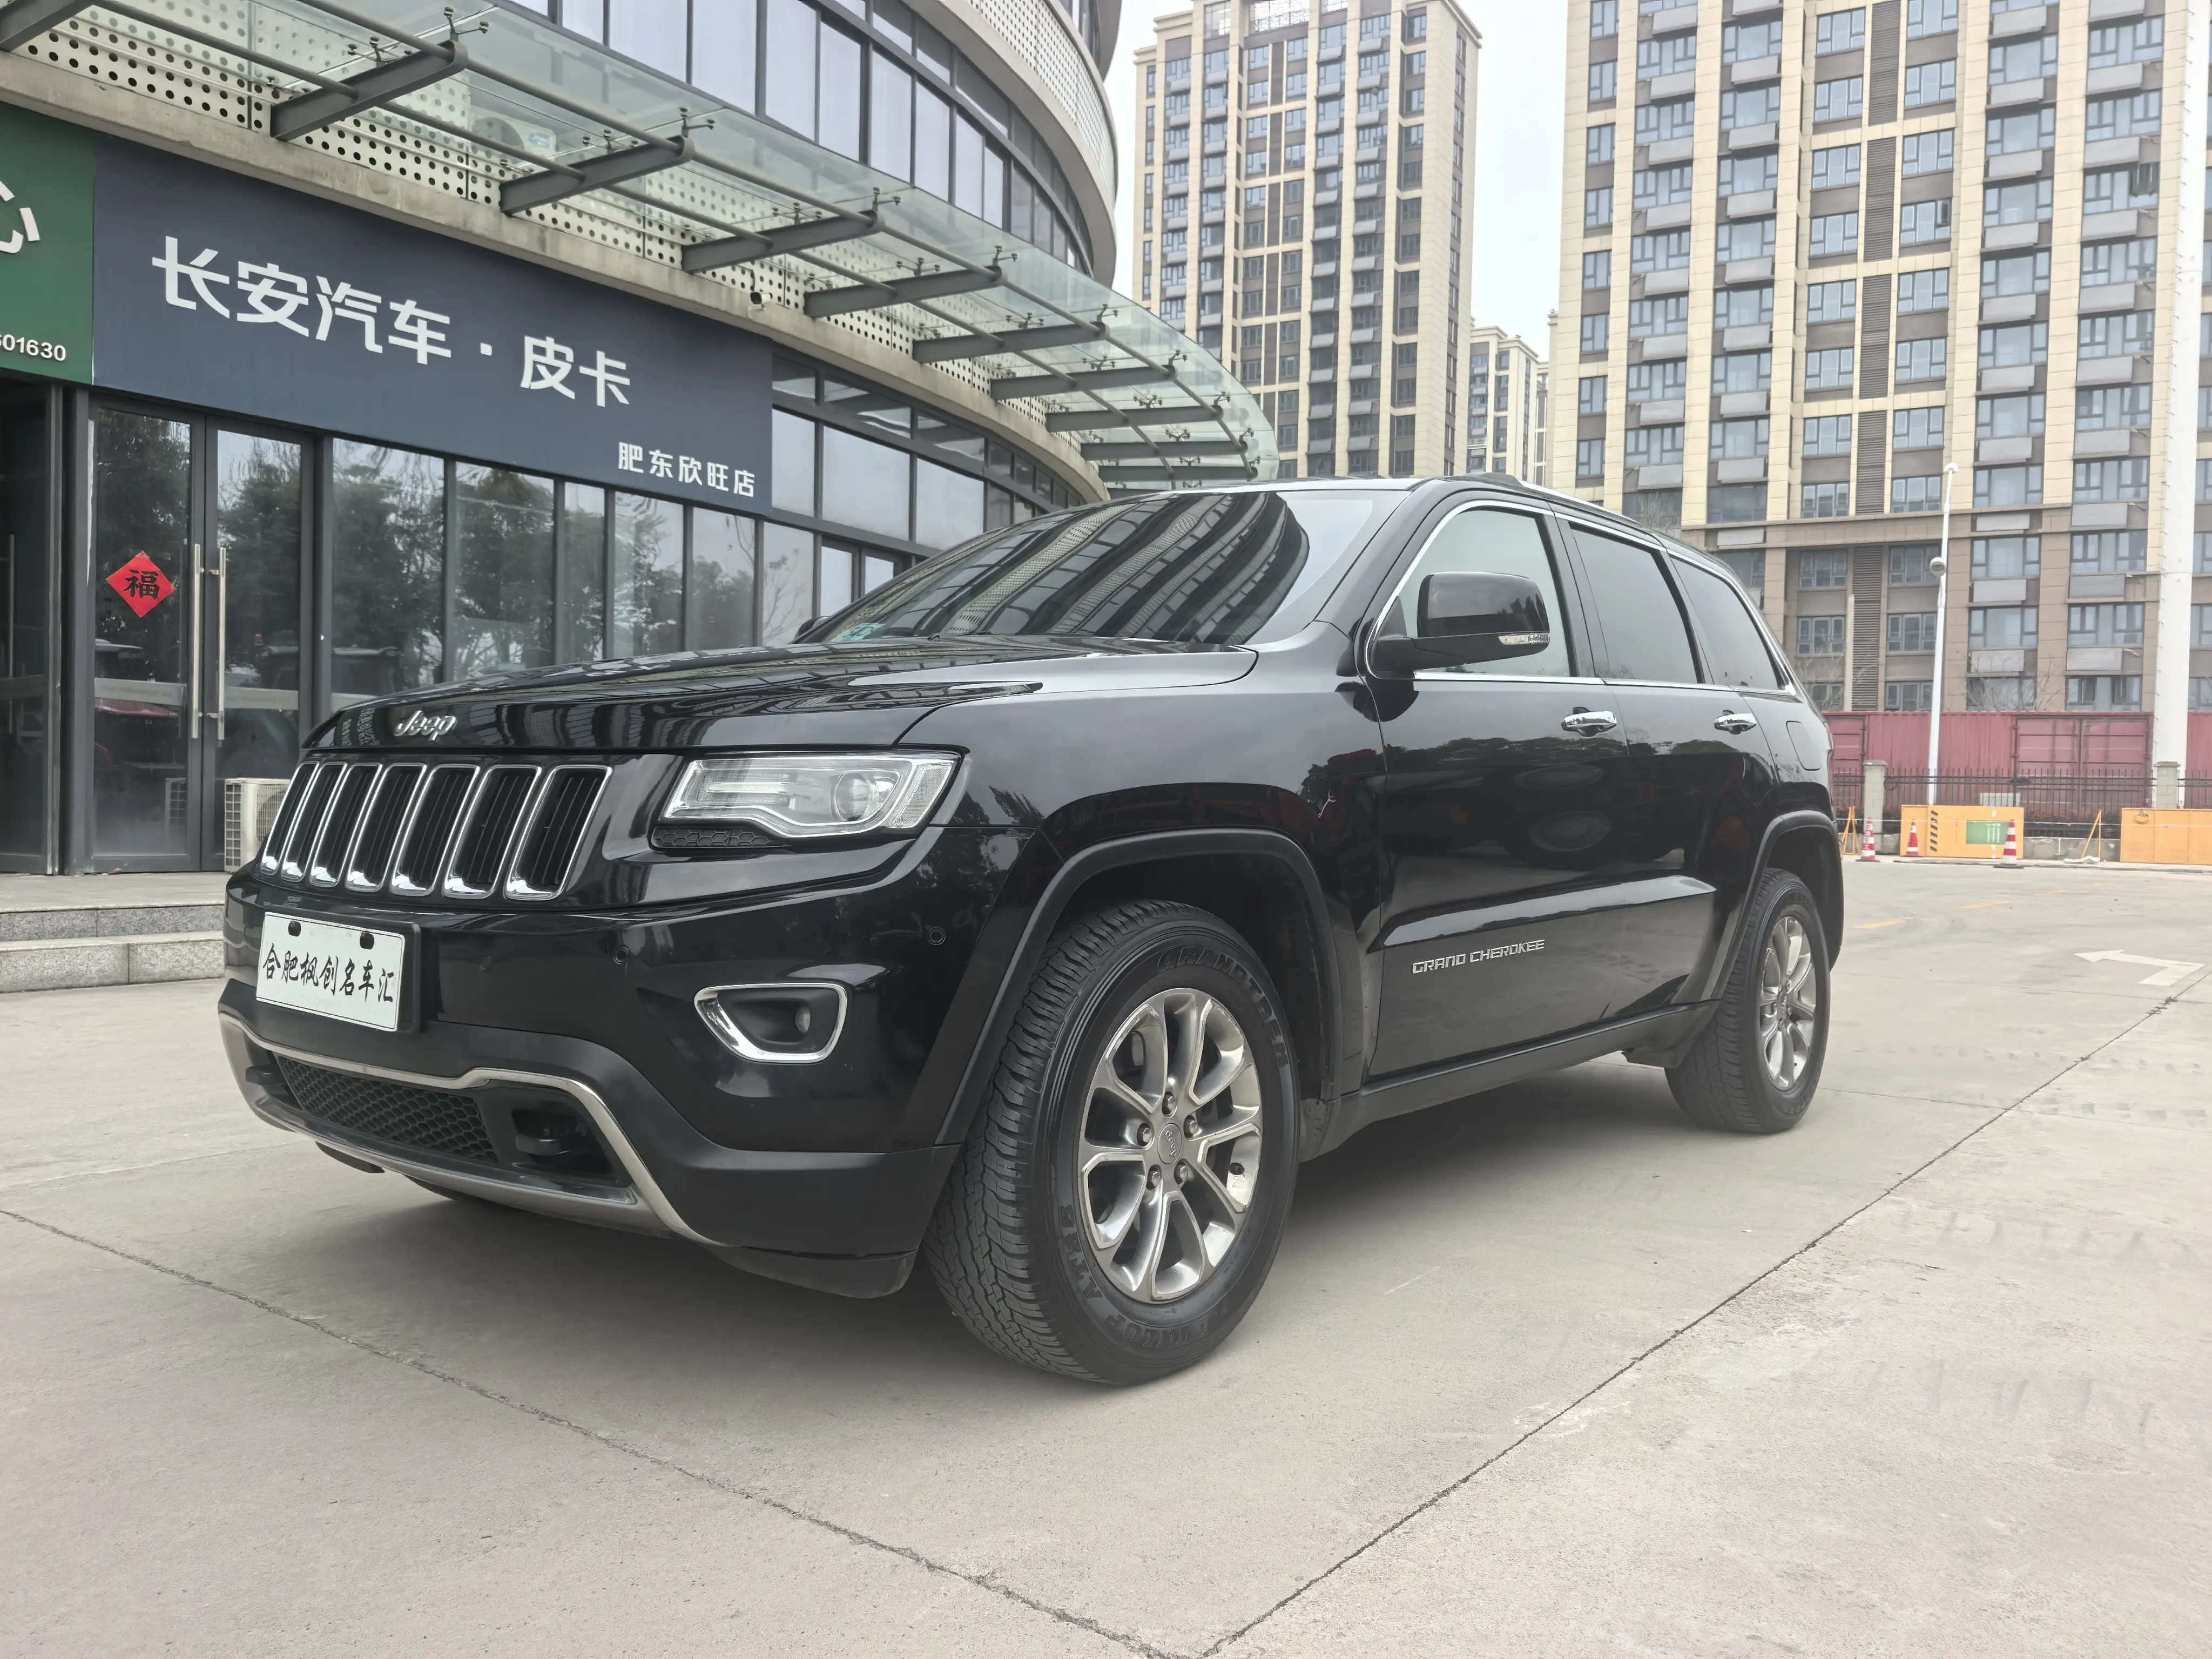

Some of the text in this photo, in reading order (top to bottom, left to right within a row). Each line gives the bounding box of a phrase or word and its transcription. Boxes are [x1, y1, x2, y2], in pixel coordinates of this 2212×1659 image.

[0, 334, 66, 361] 01630
[618, 441, 755, 497] 肥东欣旺店
[123, 569, 160, 601] 福
[394, 710, 457, 742] Jeep
[262, 942, 395, 1003] 合肥枫创名车汇
[1412, 939, 1545, 974] GRAND CHEROKEE
